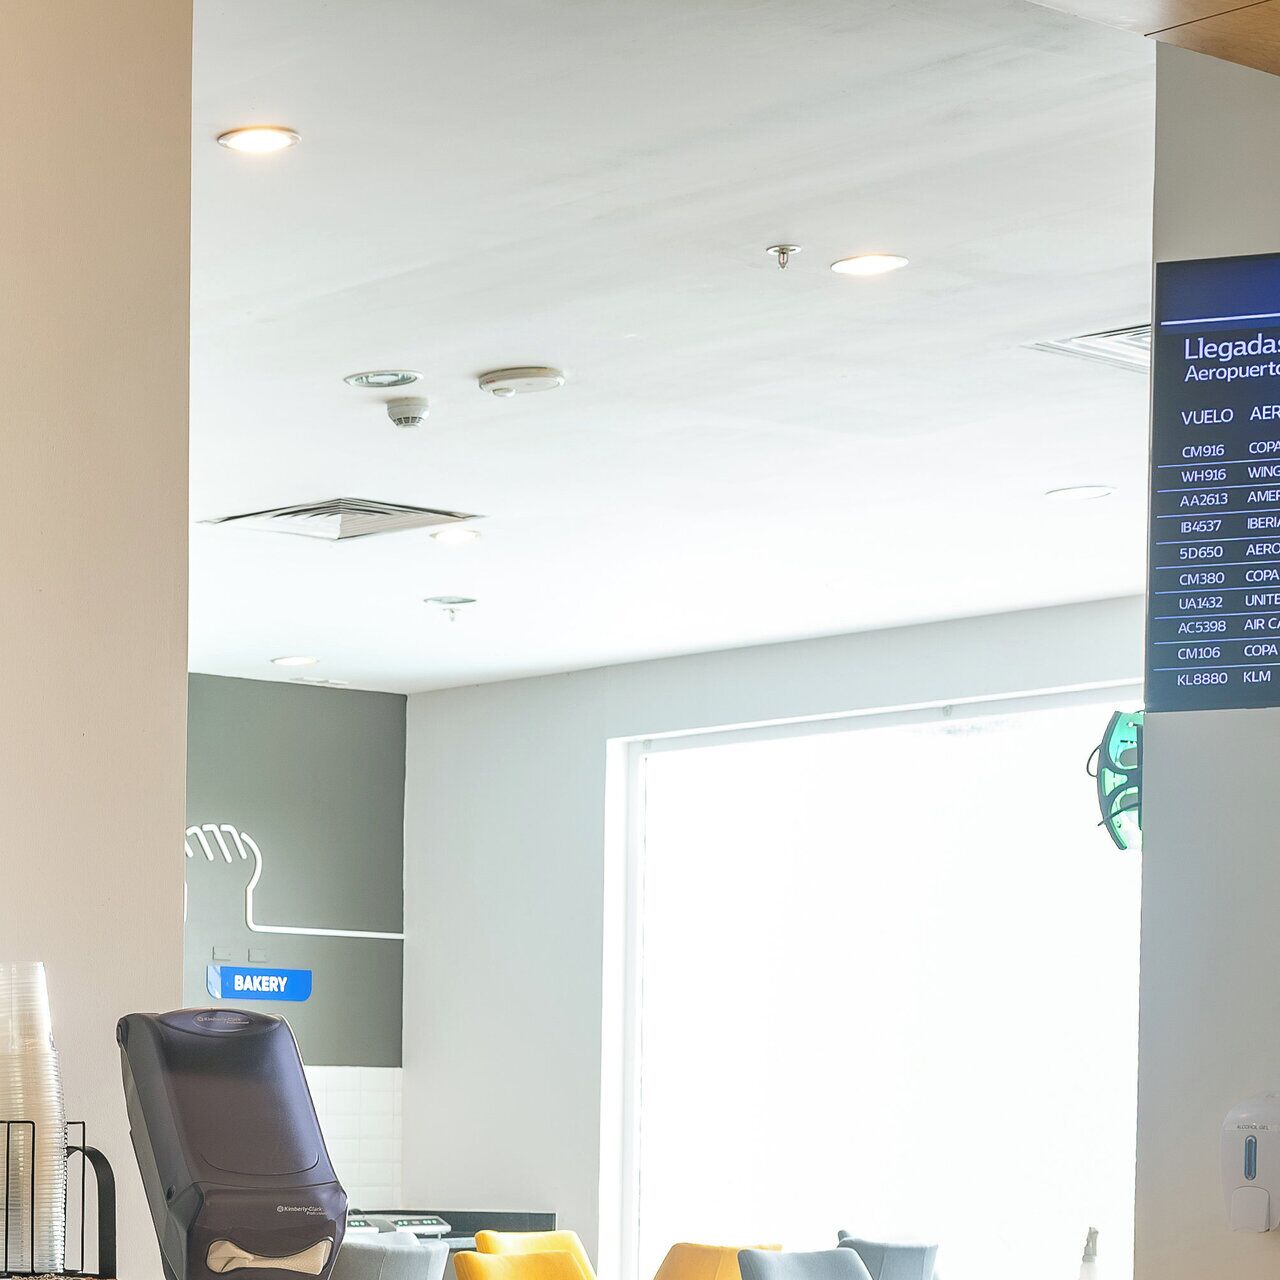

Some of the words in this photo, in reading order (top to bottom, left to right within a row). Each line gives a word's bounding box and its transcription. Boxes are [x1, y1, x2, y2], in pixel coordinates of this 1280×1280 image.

[1185, 333, 1280, 361] Llegada
[1181, 408, 1234, 425] VUELO
[1182, 444, 1225, 458] CM916
[1181, 468, 1227, 482] WH916
[1180, 492, 1228, 507] AA2613
[1181, 519, 1222, 533] IB4537
[1180, 545, 1223, 560] 5D650
[1180, 571, 1225, 586] CM380
[1245, 569, 1280, 582] COPA
[1179, 596, 1223, 610] UA1432
[1178, 620, 1227, 634] AC5398
[1244, 618, 1265, 631] AIR
[1177, 646, 1221, 660] CM106
[1244, 644, 1279, 657] COPA
[1177, 672, 1228, 686] KL8880
[1243, 670, 1271, 683] KLM
[234, 974, 288, 992] BAKERY
